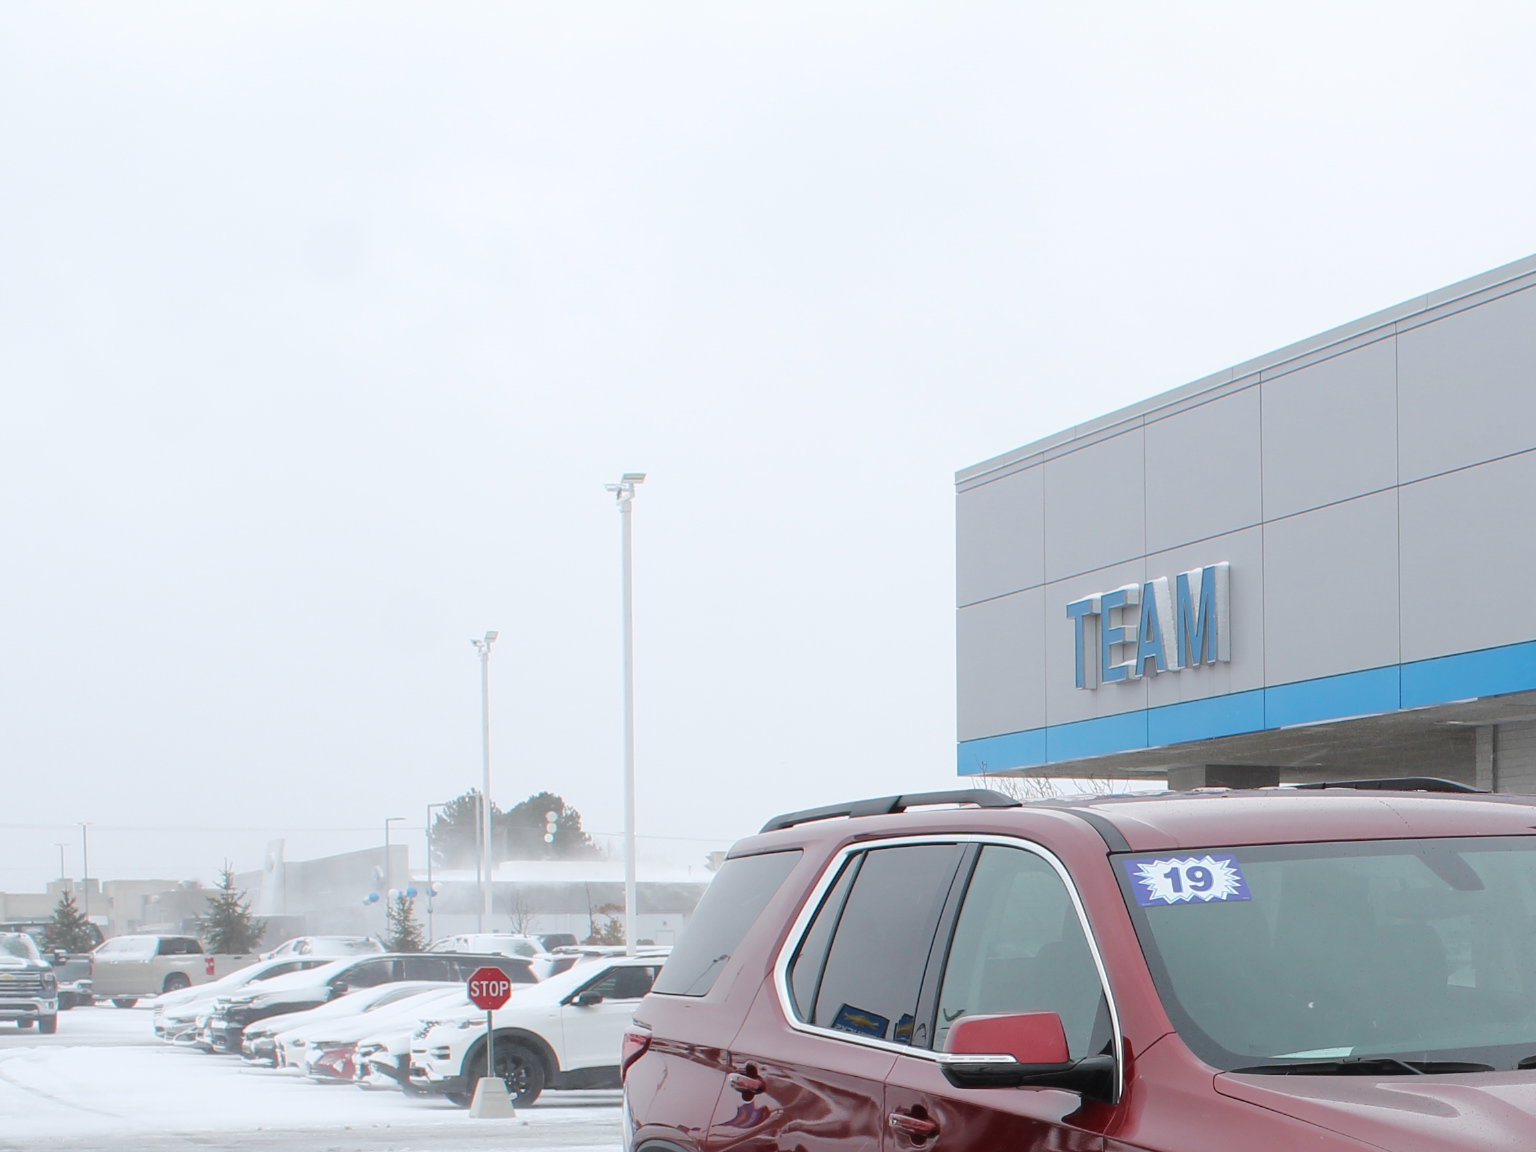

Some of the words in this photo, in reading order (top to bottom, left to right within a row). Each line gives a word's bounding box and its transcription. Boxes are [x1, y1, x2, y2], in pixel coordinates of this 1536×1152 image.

[1066, 562, 1231, 690] TEAM
[1163, 865, 1215, 893] 19
[470, 980, 509, 997] STOP
